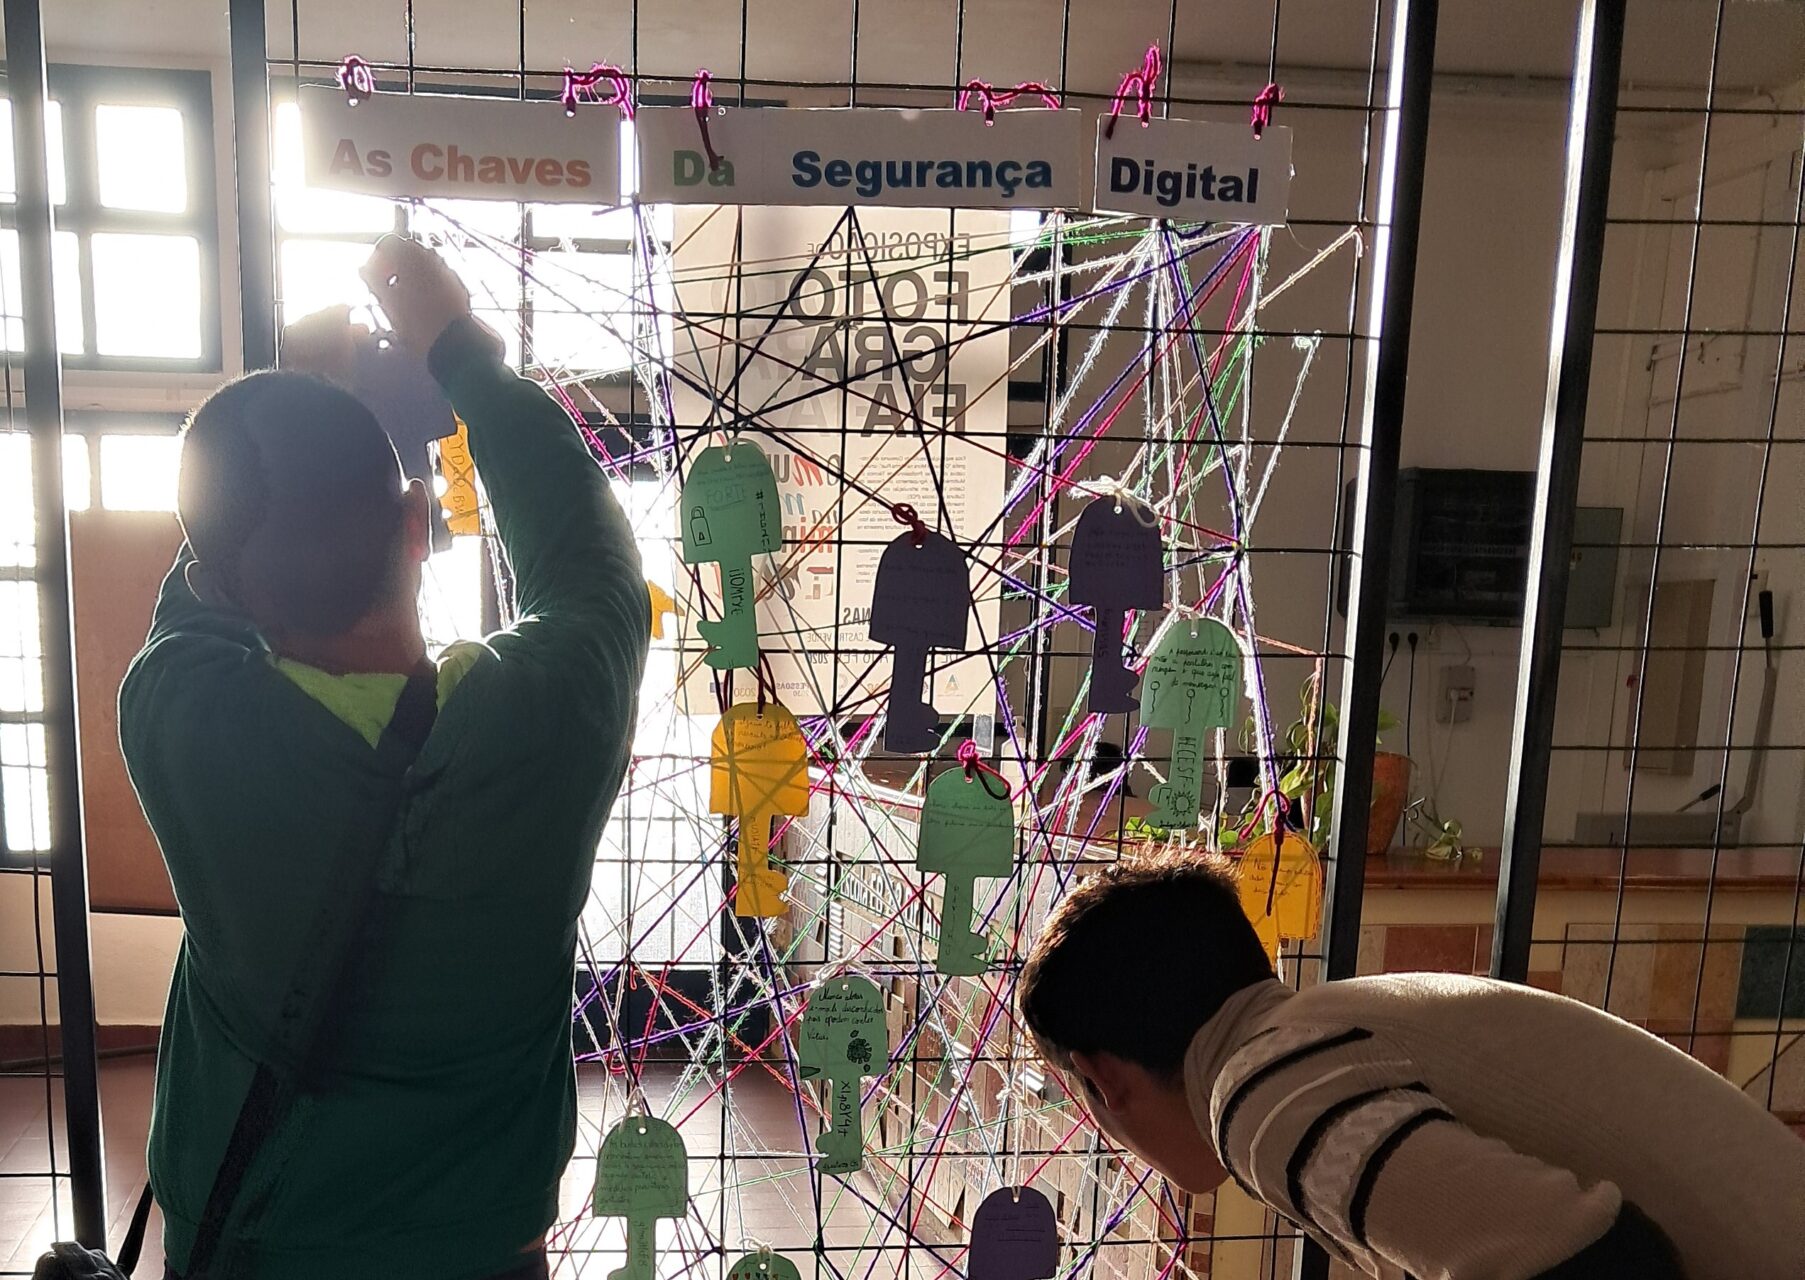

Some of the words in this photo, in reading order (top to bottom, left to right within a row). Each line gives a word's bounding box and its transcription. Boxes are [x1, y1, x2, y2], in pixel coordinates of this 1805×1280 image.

[329, 138, 393, 178] As
[409, 142, 593, 189] Chaves
[673, 149, 736, 187] Da
[791, 149, 1053, 198] Segurança
[1110, 157, 1259, 206] Digital
